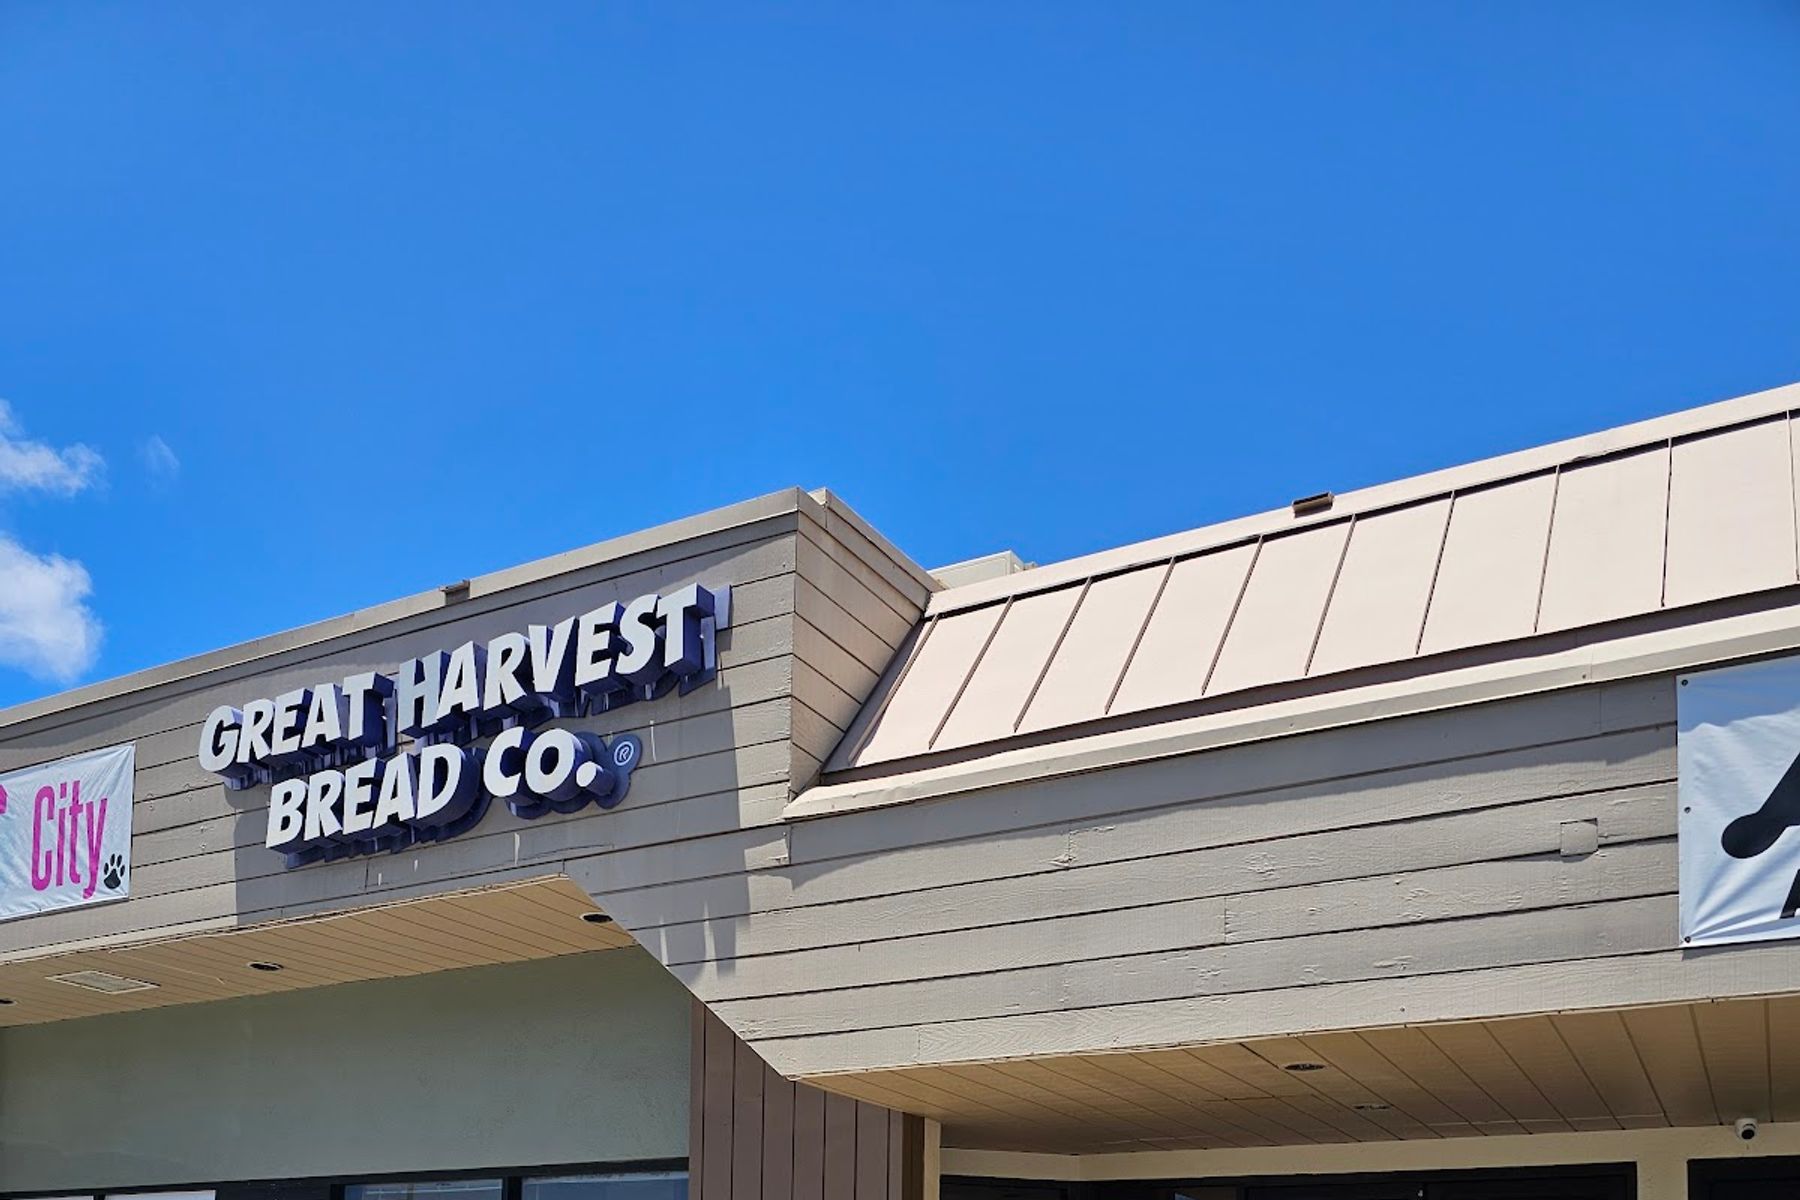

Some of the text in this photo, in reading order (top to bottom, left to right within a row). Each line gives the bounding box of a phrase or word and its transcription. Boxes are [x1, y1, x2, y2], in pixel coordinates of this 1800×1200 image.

[199, 583, 701, 772] GREAT HARVEST
[31, 780, 108, 899] City
[266, 744, 463, 849] BREAD
[483, 727, 598, 798] CO.
